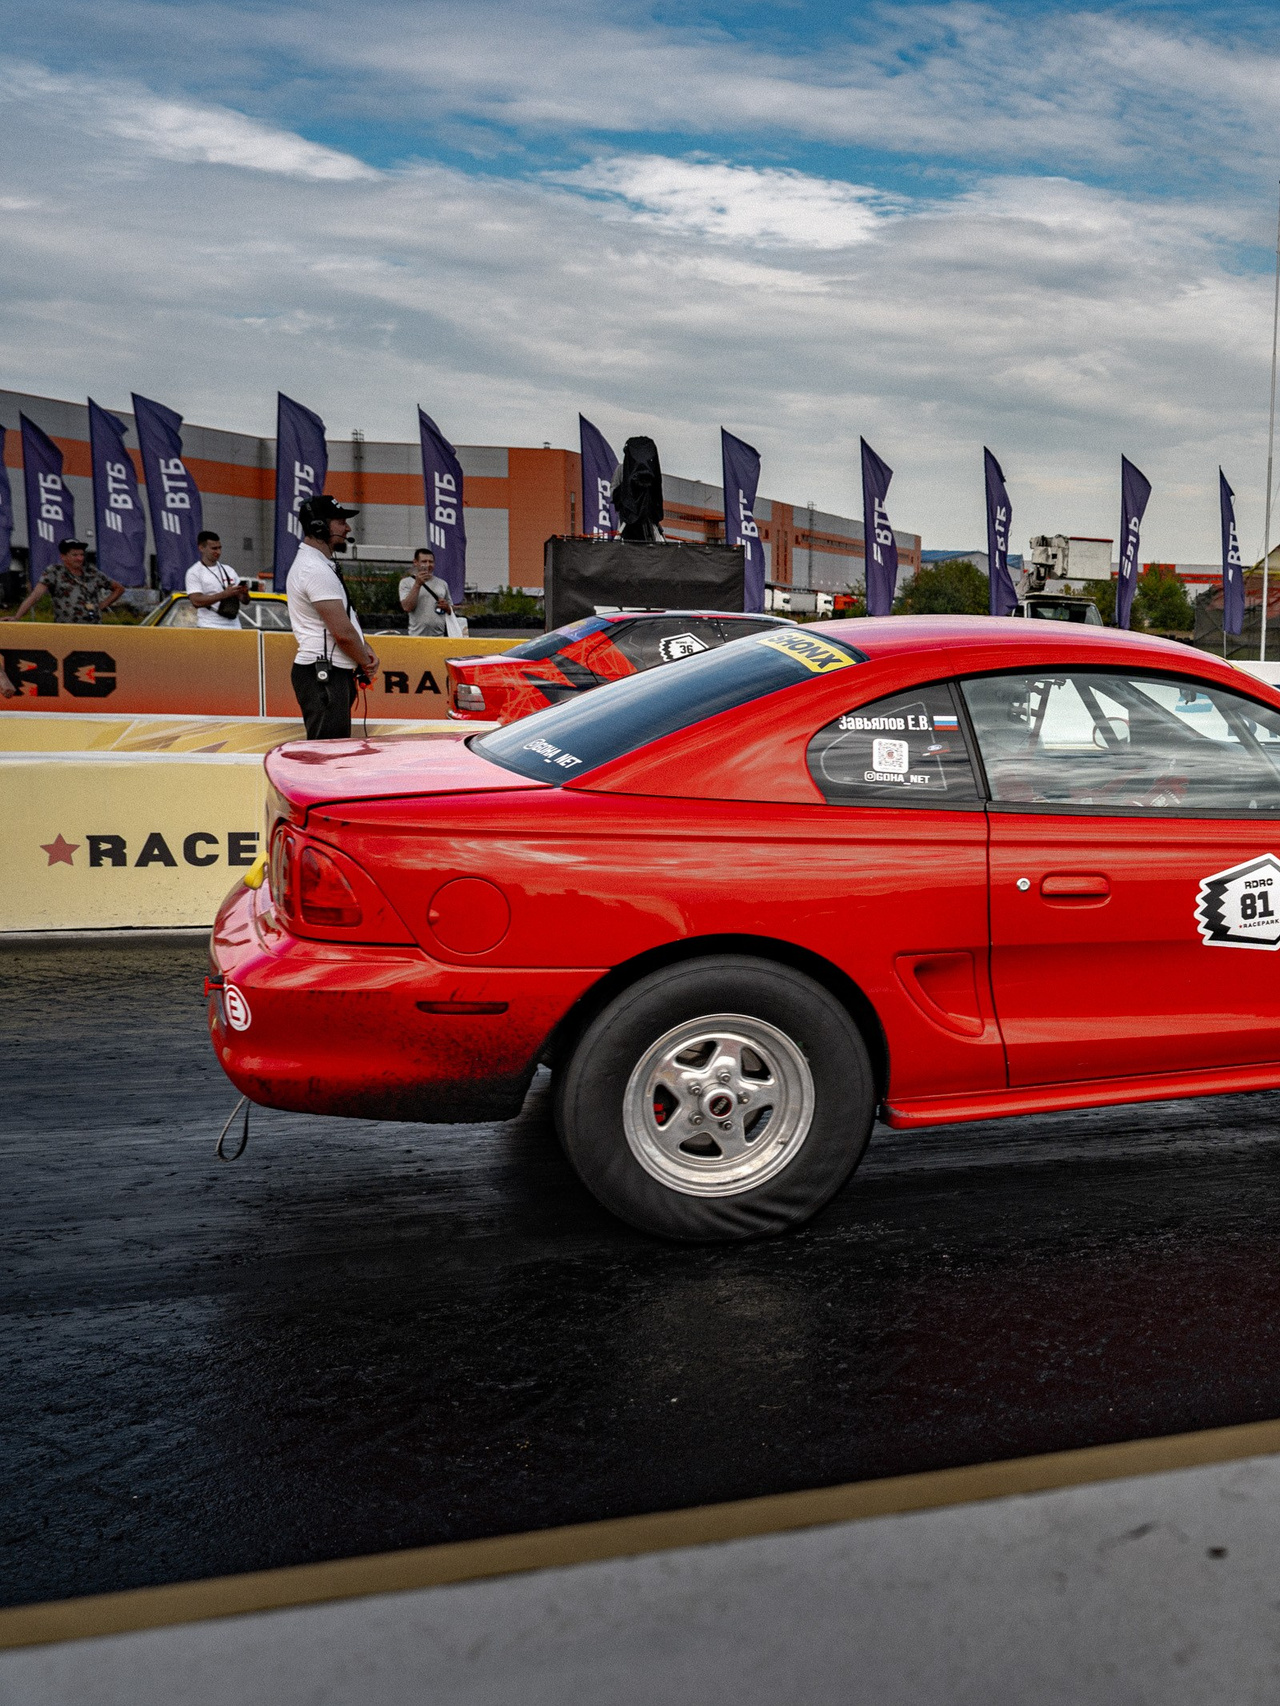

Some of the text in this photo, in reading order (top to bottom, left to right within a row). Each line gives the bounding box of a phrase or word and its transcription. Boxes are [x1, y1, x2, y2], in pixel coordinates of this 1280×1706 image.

[38, 472, 64, 521] ВТБ
[106, 461, 134, 510] ВТБ
[159, 457, 191, 509] ВТБ
[435, 471, 457, 525] ВТБ
[679, 644, 694, 654] 36
[382, 671, 451, 694] RA
[838, 715, 906, 730] Завьялов
[86, 832, 260, 867] RACE
[1245, 878, 1274, 889] RDRC
[1240, 890, 1275, 920] 81
[1243, 918, 1280, 929] RACEPARK
